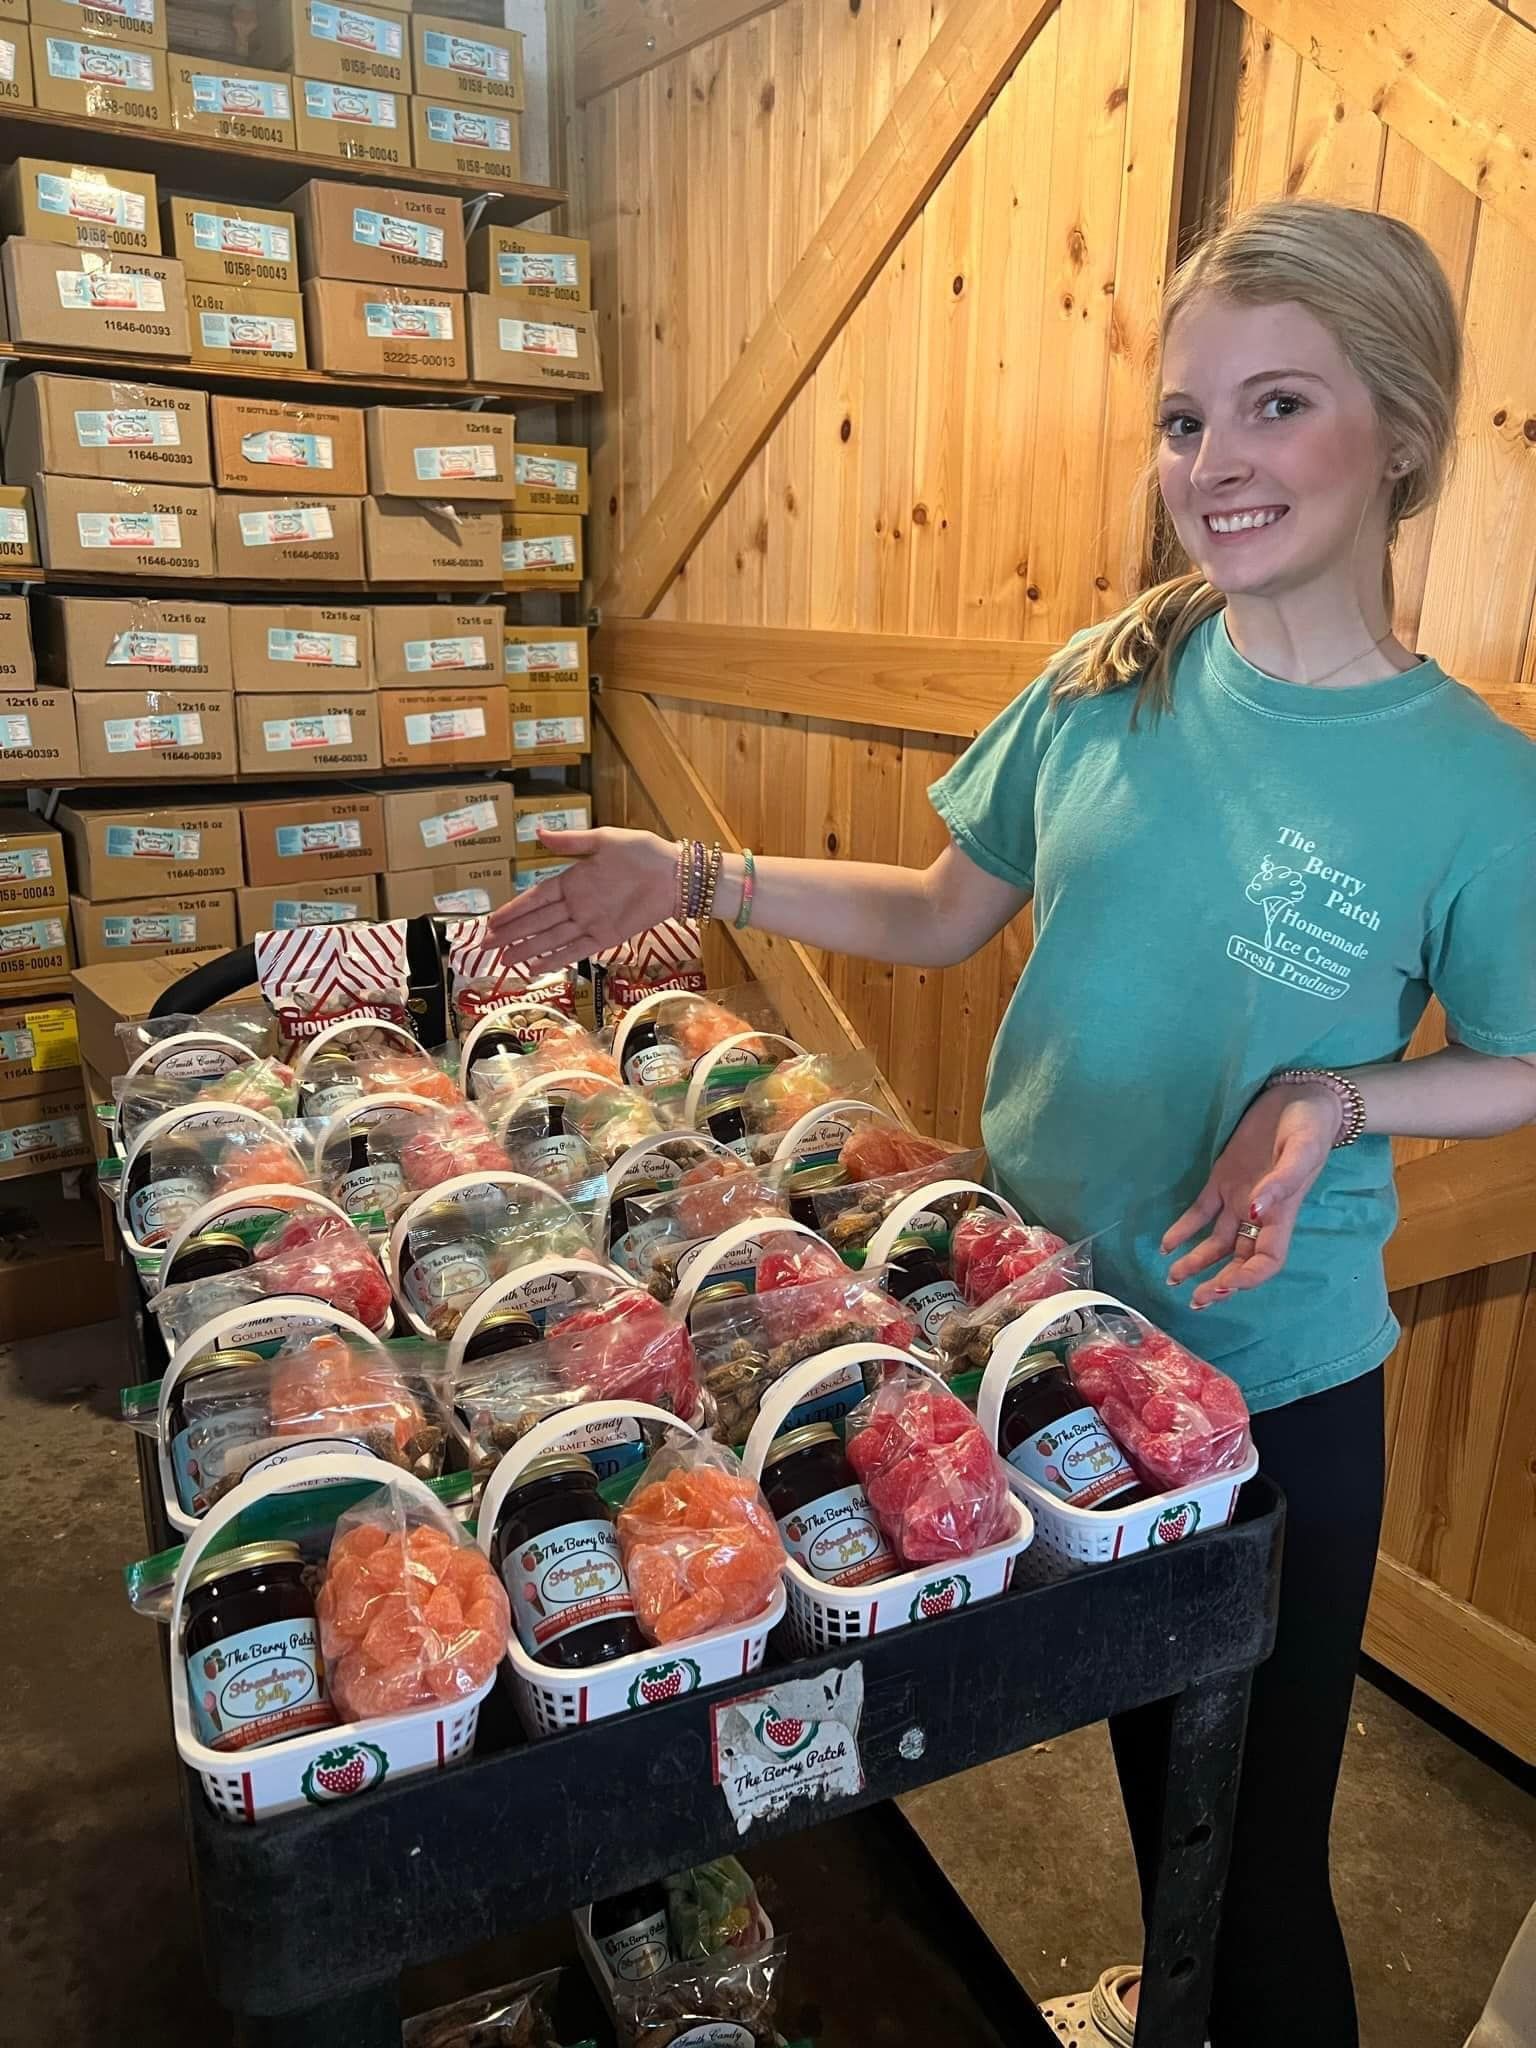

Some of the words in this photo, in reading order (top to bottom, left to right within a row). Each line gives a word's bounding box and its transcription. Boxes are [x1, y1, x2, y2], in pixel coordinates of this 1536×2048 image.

[340, 58, 401, 81] 10158-00043
[88, 96, 158, 120] 58-00043
[405, 202, 432, 214] 12x16
[434, 207, 446, 216] oz
[223, 260, 288, 281] 10158-00043
[104, 320, 171, 337] 11646-00393
[384, 351, 456, 368] 32225-00013
[144, 397, 175, 409] 12x16
[178, 401, 191, 410] oz
[128, 450, 193, 464] 11646-00393
[153, 504, 184, 514] 12x16
[186, 507, 198, 516] oz
[137, 556, 200, 568] 11646-00393
[282, 550, 340, 561] 11646-00393
[162, 613, 191, 623] 12x16
[194, 616, 207, 624] oz
[320, 611, 345, 621] 12x16
[348, 614, 361, 622] oz
[456, 616, 480, 625] 12x16
[5, 697, 38, 707] 12x16
[41, 698, 55, 707] oz
[177, 703, 205, 712] 12x16
[208, 704, 220, 712] oz
[161, 752, 222, 761] 11646-00393
[331, 805, 356, 815] 12x16
[180, 821, 209, 831] 12x16
[211, 821, 223, 829] oz
[1275, 825, 1317, 854] The
[166, 867, 226, 880] 11646-00393
[1302, 855, 1367, 898] Berry
[323, 887, 349, 897] 12x16
[178, 901, 205, 911] 12x16
[1323, 889, 1382, 932] Patch
[1281, 908, 1369, 961] Homemade
[1273, 931, 1302, 956] Ice
[1304, 945, 1352, 979] Cream
[1233, 940, 1277, 974] Fresh
[1278, 961, 1342, 998] Produce
[291, 1005, 391, 1037] HOUSTON'S
[166, 1057, 194, 1070] Smith
[195, 1054, 226, 1069] Candy
[818, 1127, 845, 1143] Candy
[642, 1159, 670, 1172] Candy
[909, 1218, 937, 1231] Candy
[499, 1290, 518, 1303] ith
[520, 1277, 558, 1297] Candy
[919, 1294, 938, 1309] The
[231, 1326, 285, 1343] GOURMET
[585, 1417, 623, 1434] Candy
[589, 1431, 628, 1447] SNACKS
[1054, 1428, 1075, 1447] The
[1072, 1421, 1099, 1439] Berry
[804, 1513, 826, 1533] The
[824, 1504, 854, 1522] Berry
[542, 1541, 565, 1560] The
[564, 1536, 599, 1552] Berry
[548, 1559, 616, 1588] Strawberry
[578, 1598, 602, 1612] CREAM
[223, 1649, 250, 1670] The
[249, 1640, 289, 1658] Berry
[228, 1667, 307, 1700] Strawberry
[257, 1713, 284, 1727] CREAM
[734, 1771, 762, 1793] The
[762, 1760, 804, 1782] Berry
[805, 1742, 848, 1768] Patch
[676, 2034, 706, 2048] Smith
[709, 2027, 743, 2043] Candy
